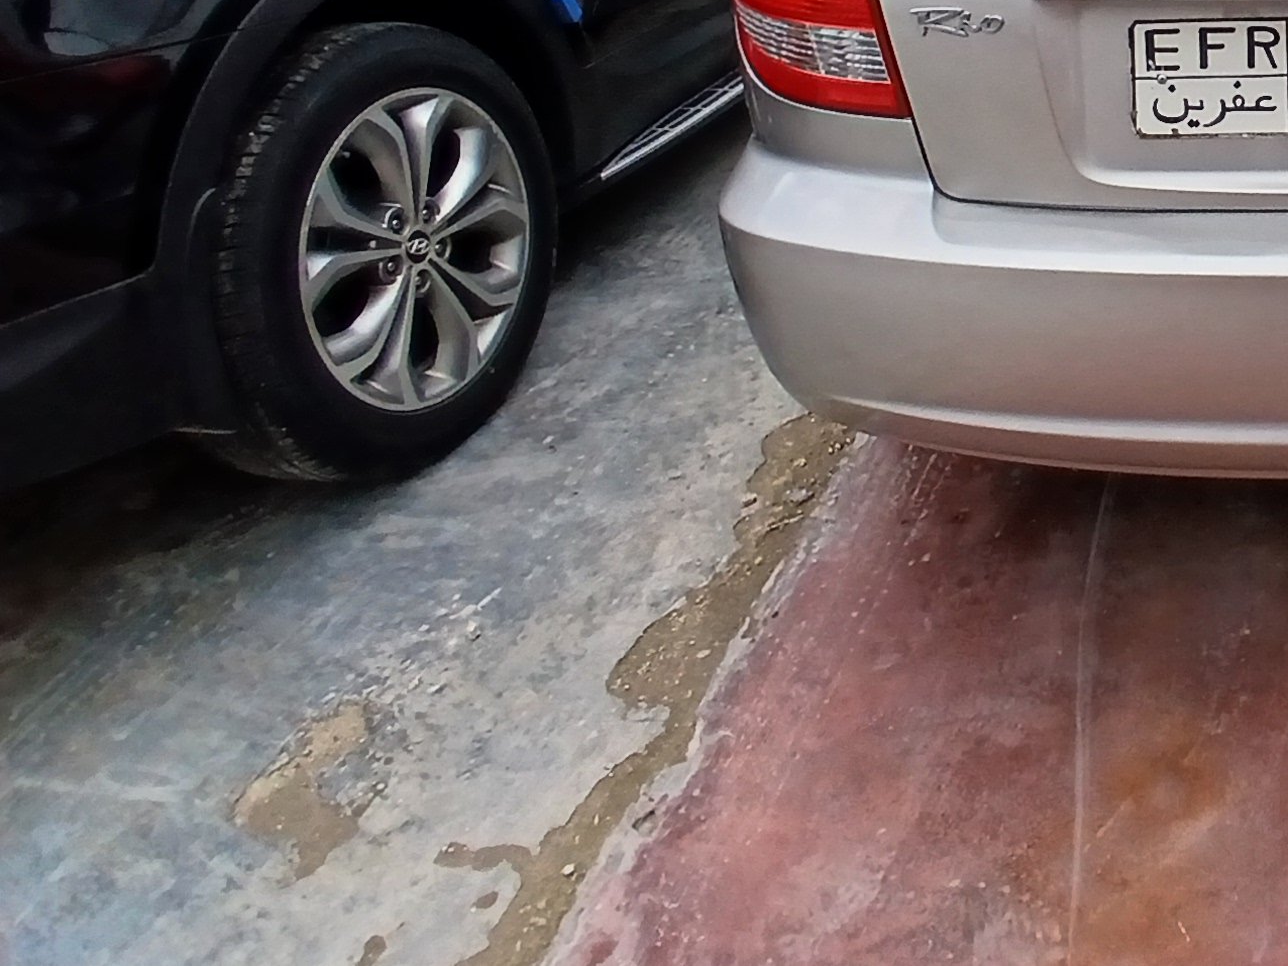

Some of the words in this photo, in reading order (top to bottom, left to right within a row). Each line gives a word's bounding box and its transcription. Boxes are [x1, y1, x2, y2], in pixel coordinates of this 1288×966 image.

[909, 6, 1006, 38] Rio
[1144, 25, 1282, 72] EFR
[1152, 79, 1278, 128] عفرين
